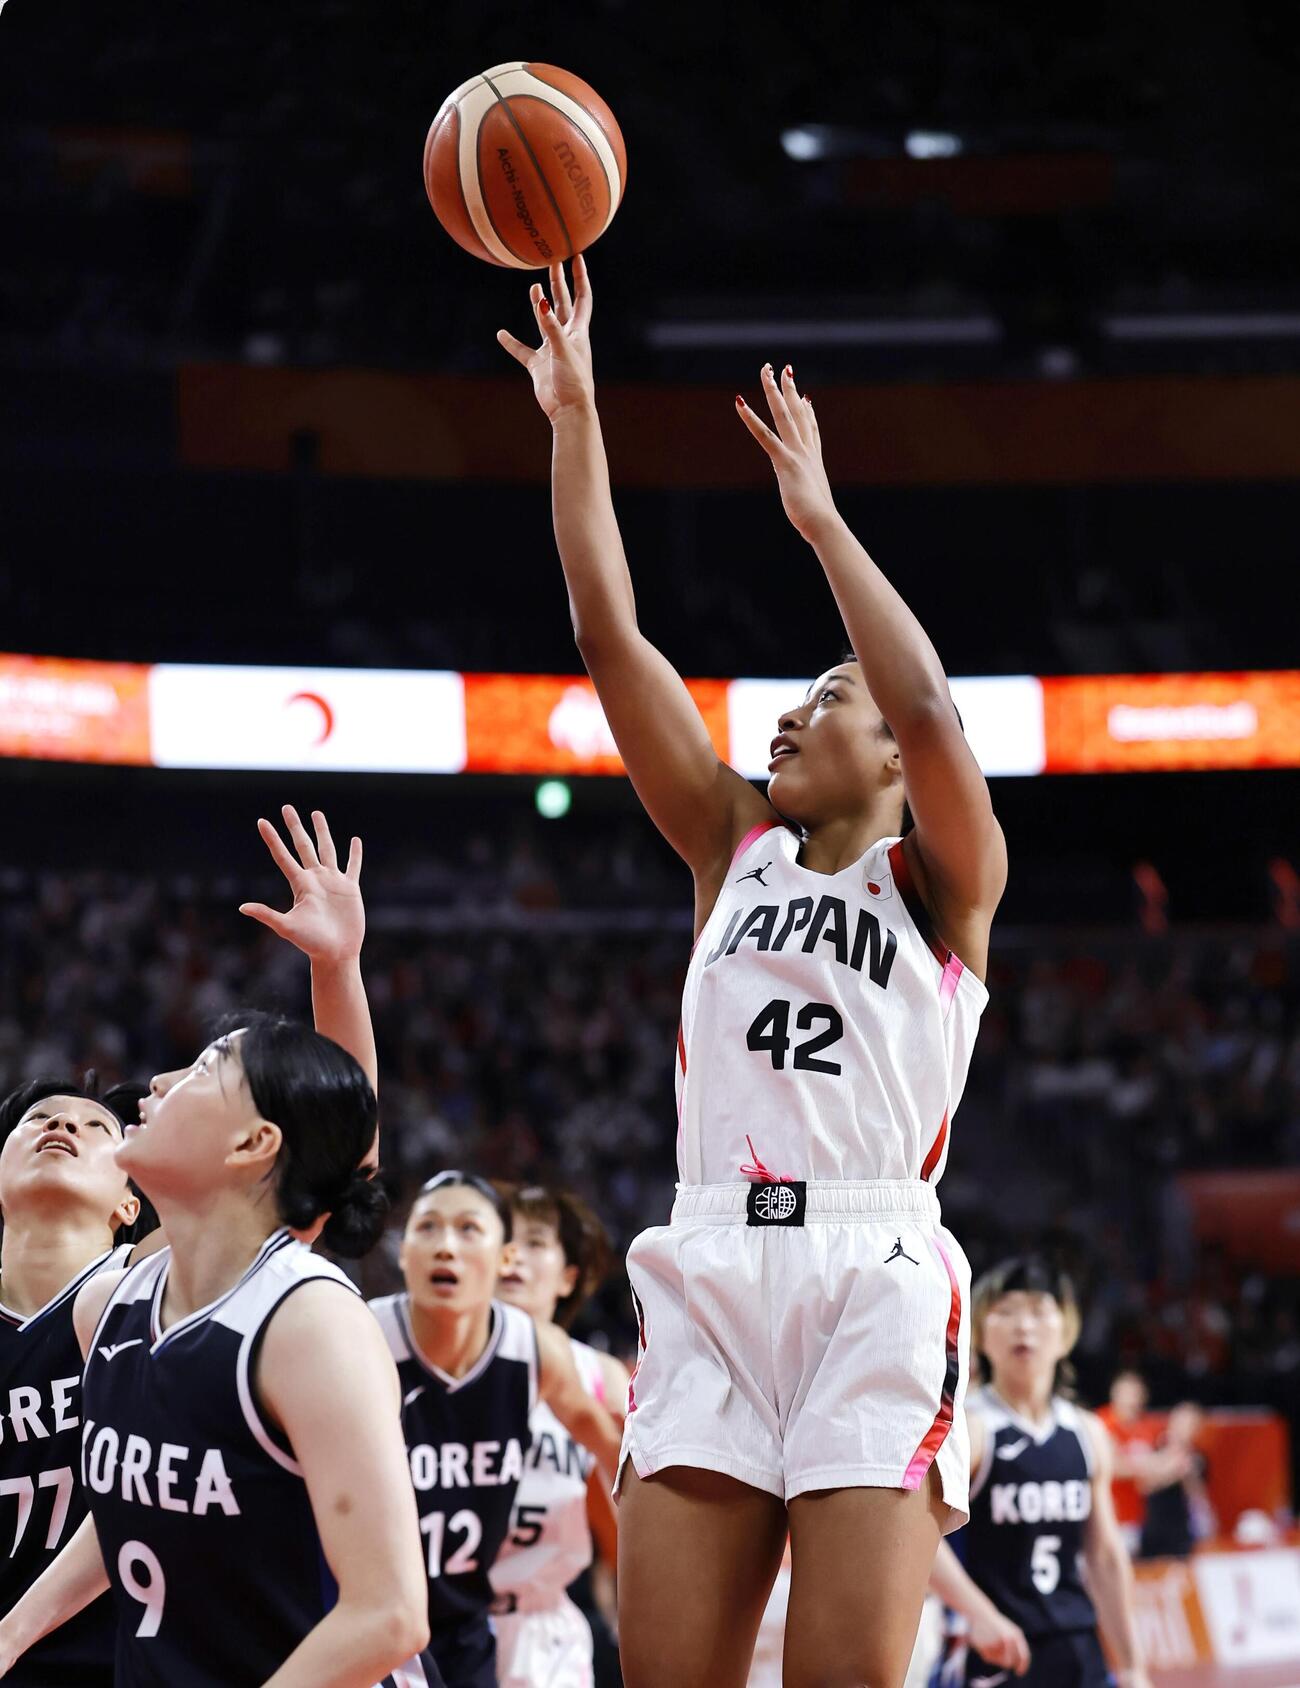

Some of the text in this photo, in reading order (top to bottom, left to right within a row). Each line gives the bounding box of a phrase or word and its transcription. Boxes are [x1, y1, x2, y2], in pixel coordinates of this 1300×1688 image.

[497, 148, 539, 238] Aichi-Nagoya
[552, 142, 597, 222] molten
[704, 894, 898, 990] JAPAN
[746, 999, 844, 1076] 42
[410, 1438, 523, 1491] OREA
[0, 1465, 74, 1559] 77
[419, 1509, 482, 1578] 12
[117, 1539, 166, 1638] 9
[1030, 1535, 1061, 1595] 5
